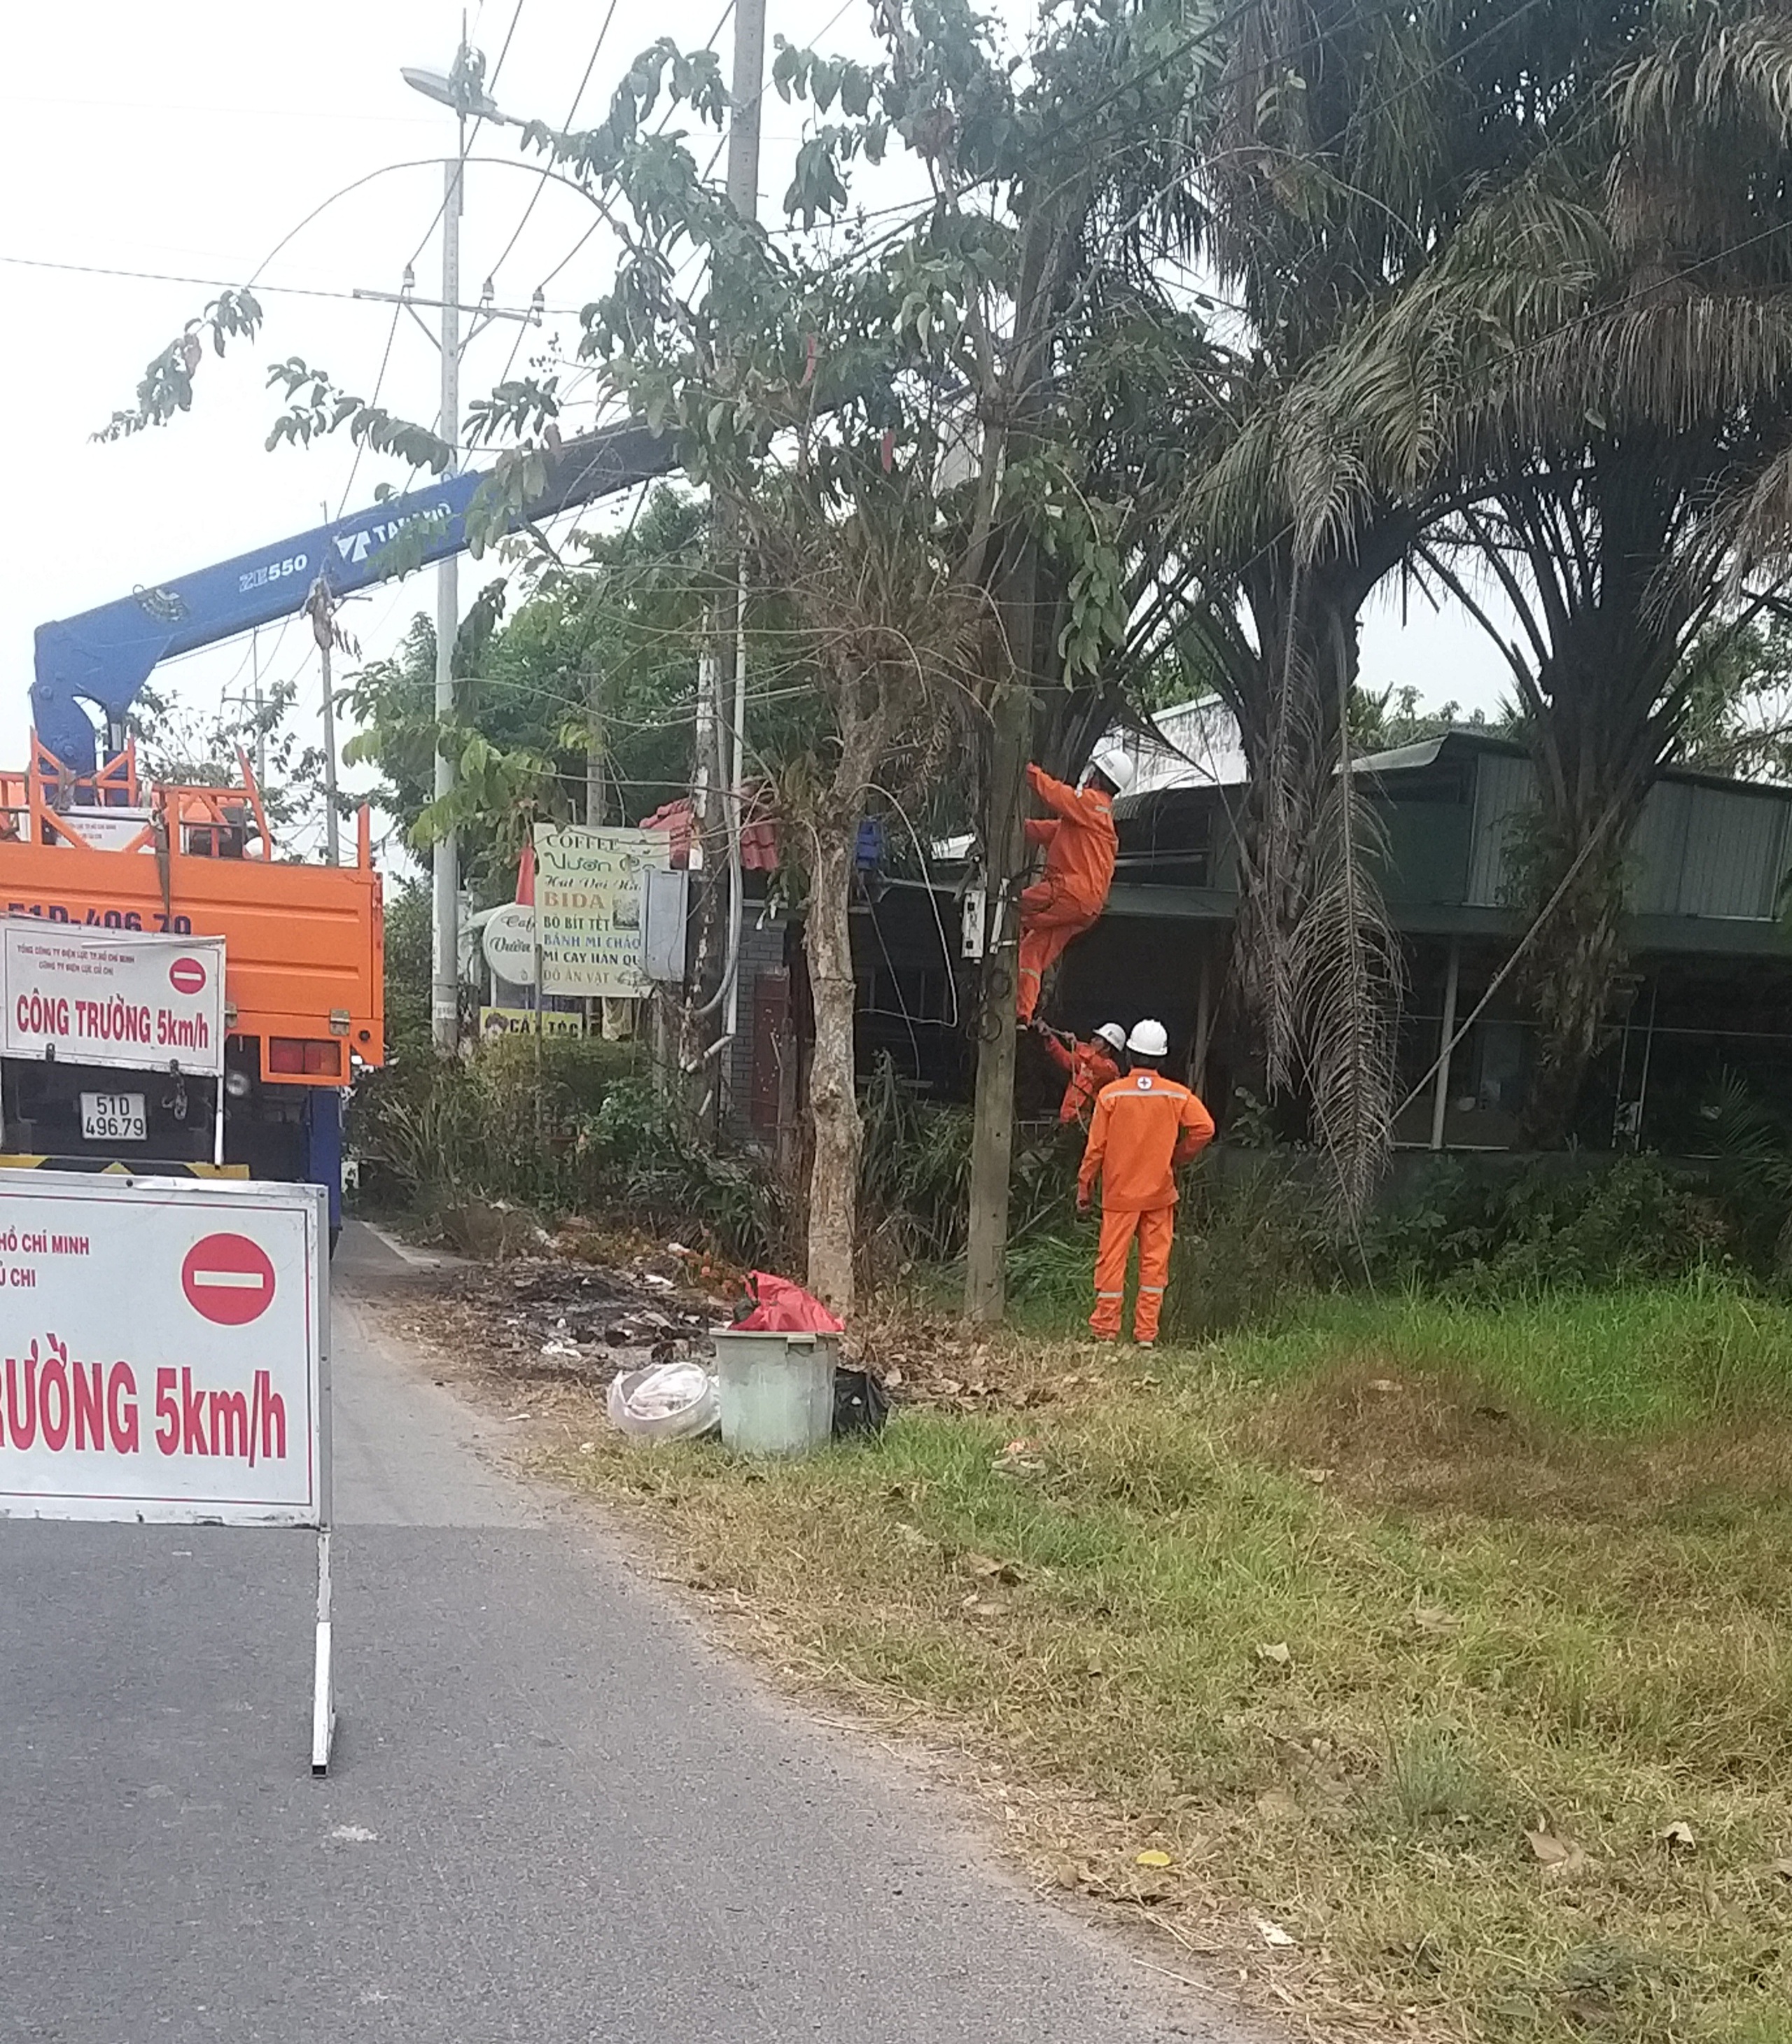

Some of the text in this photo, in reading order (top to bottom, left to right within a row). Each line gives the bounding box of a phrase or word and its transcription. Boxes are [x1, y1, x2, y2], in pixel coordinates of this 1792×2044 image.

[544, 890, 606, 909] BIDA
[563, 951, 587, 963] CAY
[16, 987, 209, 1052] CÔNG TRƯỜNG 5km/h
[97, 1096, 130, 1116] 51D
[85, 1116, 144, 1137] 496.79
[22, 1229, 48, 1253] CHÍ
[52, 1235, 89, 1255] MINH
[10, 1268, 36, 1287] CHI
[155, 1366, 286, 1468] 5km/h
